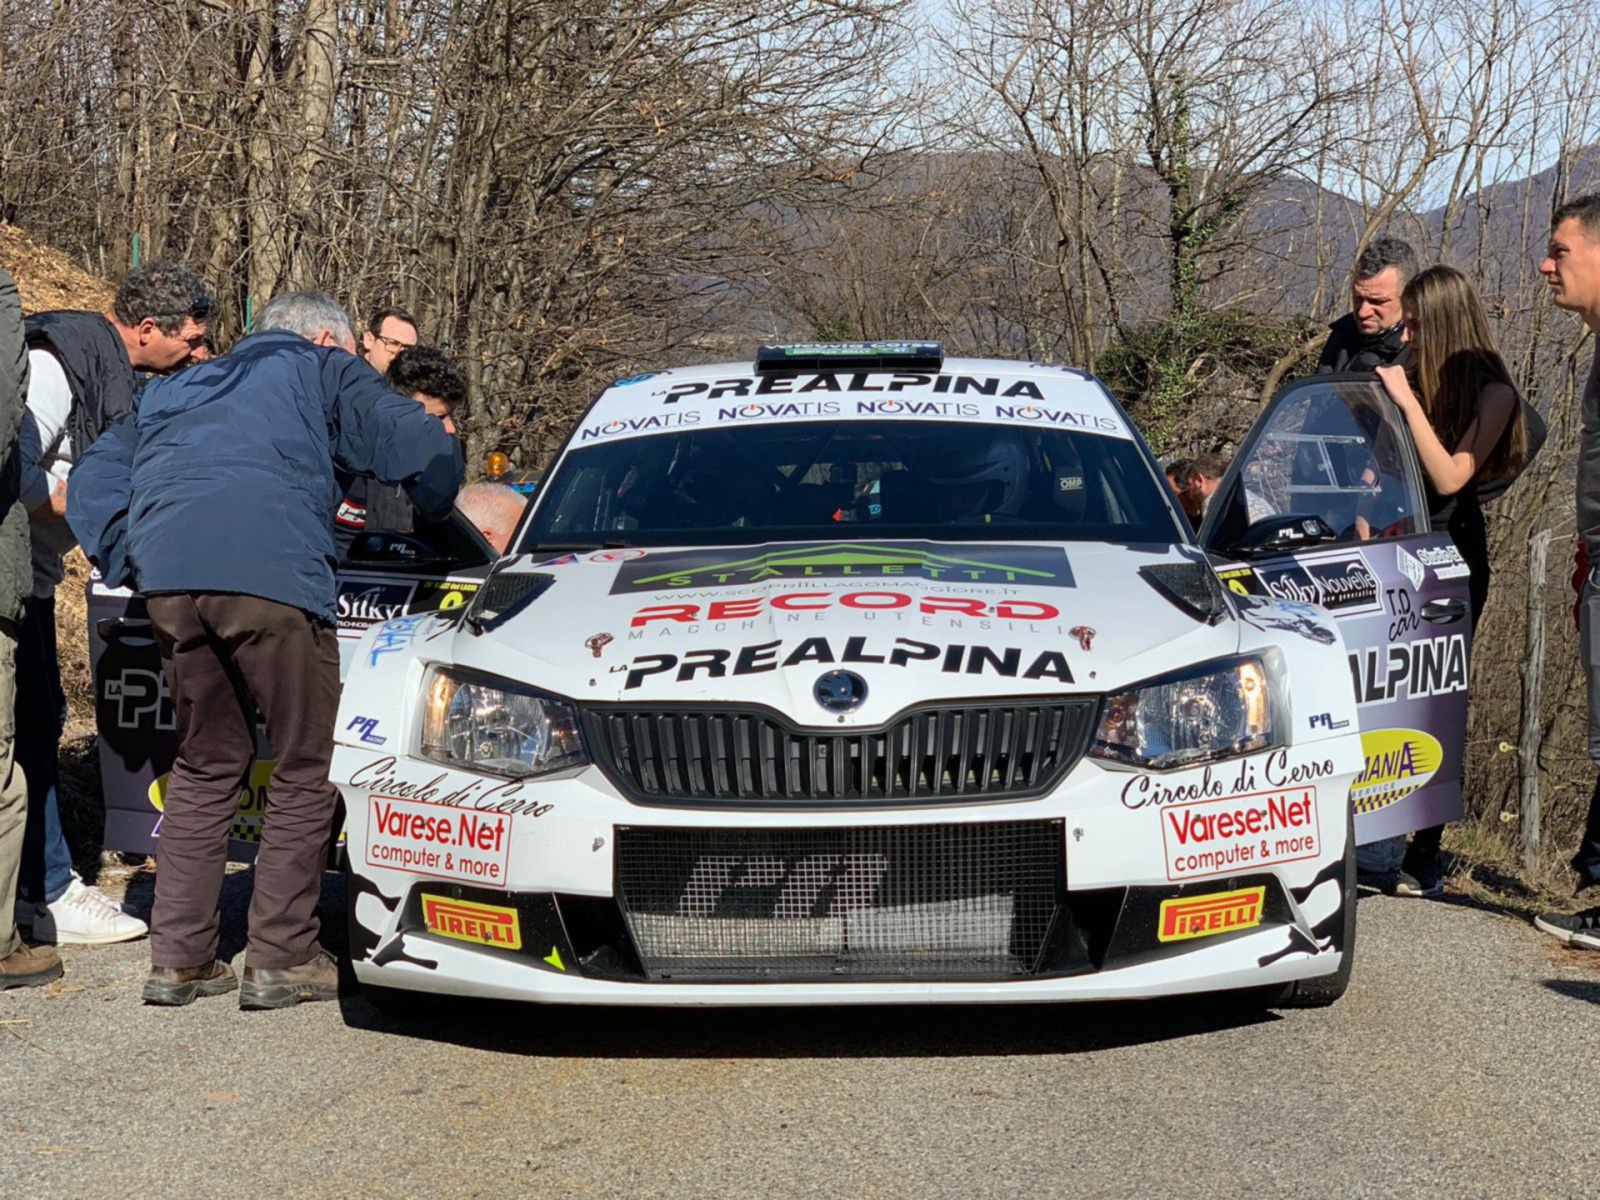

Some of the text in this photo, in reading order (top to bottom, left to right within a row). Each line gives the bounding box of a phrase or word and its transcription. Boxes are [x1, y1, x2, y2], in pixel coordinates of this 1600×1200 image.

[651, 373, 1045, 404] LA PREALPINA
[719, 401, 840, 420] NOVATIS
[857, 400, 979, 416] NOVATIS
[996, 405, 1117, 431] NOVATIS
[581, 411, 700, 440] NOVATIS
[1060, 479, 1082, 489] OMP
[667, 564, 1015, 586] STALLETTI
[1270, 576, 1316, 603] Silky
[1316, 572, 1376, 594] Nouvelle
[337, 588, 402, 620] Silky
[630, 591, 1060, 627] RECORD
[1339, 589, 1376, 602] generation
[628, 612, 1062, 640] MACCHINE UTENSILI
[1388, 611, 1420, 641] car
[609, 636, 1075, 690] LA PREALPINA
[108, 684, 122, 695] LA
[350, 756, 554, 818] Circolo di Cerro
[1121, 751, 1333, 809] Circolo di Cerro
[1351, 781, 1396, 798] SERVICE
[374, 801, 504, 852] Varese.Net
[1169, 792, 1311, 844] Varese.Net
[371, 843, 499, 878] computer & more
[1174, 835, 1314, 872] computer & more
[426, 900, 514, 943] PIRELLI
[1163, 893, 1259, 936] PIRELLI
